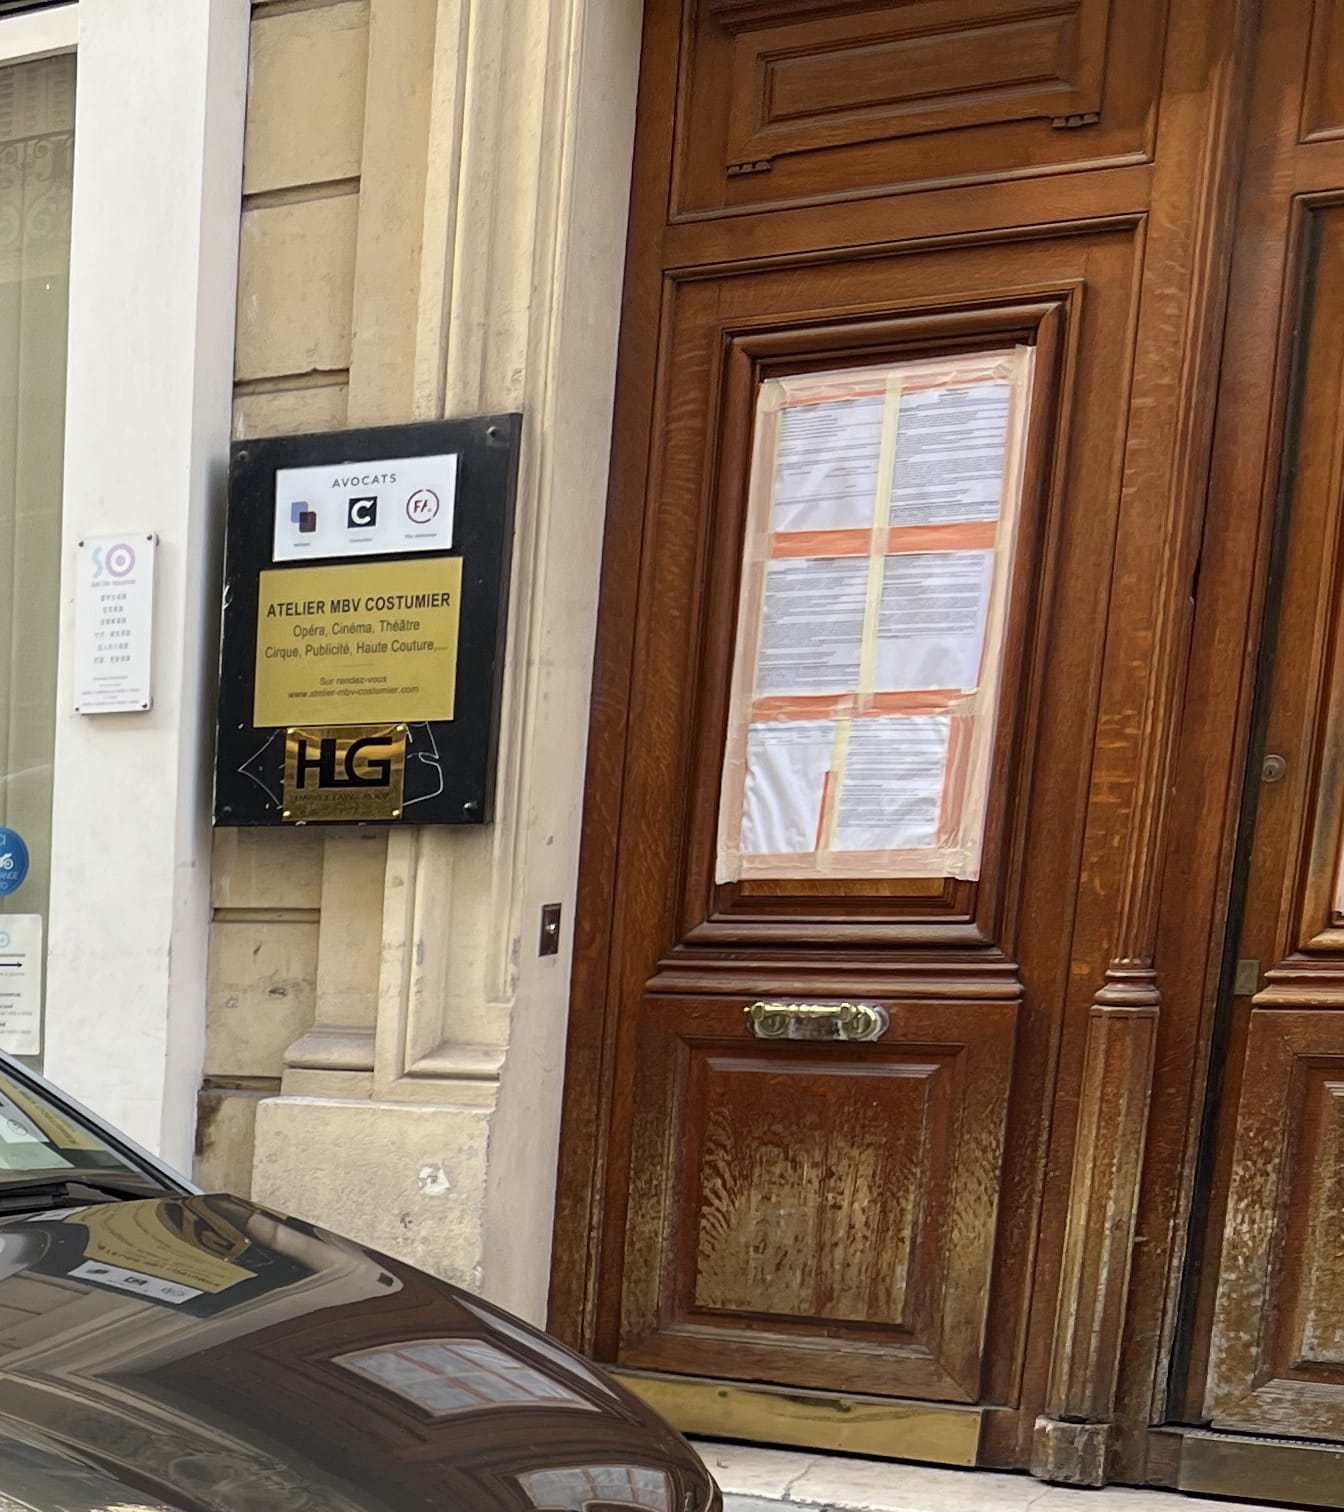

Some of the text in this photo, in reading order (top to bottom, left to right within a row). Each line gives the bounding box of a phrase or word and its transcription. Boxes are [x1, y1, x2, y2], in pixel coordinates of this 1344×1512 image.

[331, 473, 398, 489] AVOCATS
[266, 593, 452, 618] ATELIER MBV COSTUMIER
[293, 619, 421, 640] Opéra, Cinéma, Théâtre
[265, 646, 302, 661] Cirque,
[305, 643, 353, 657] Publicité,
[356, 641, 388, 654] Haute
[319, 675, 387, 686] Sur rendez-vous
